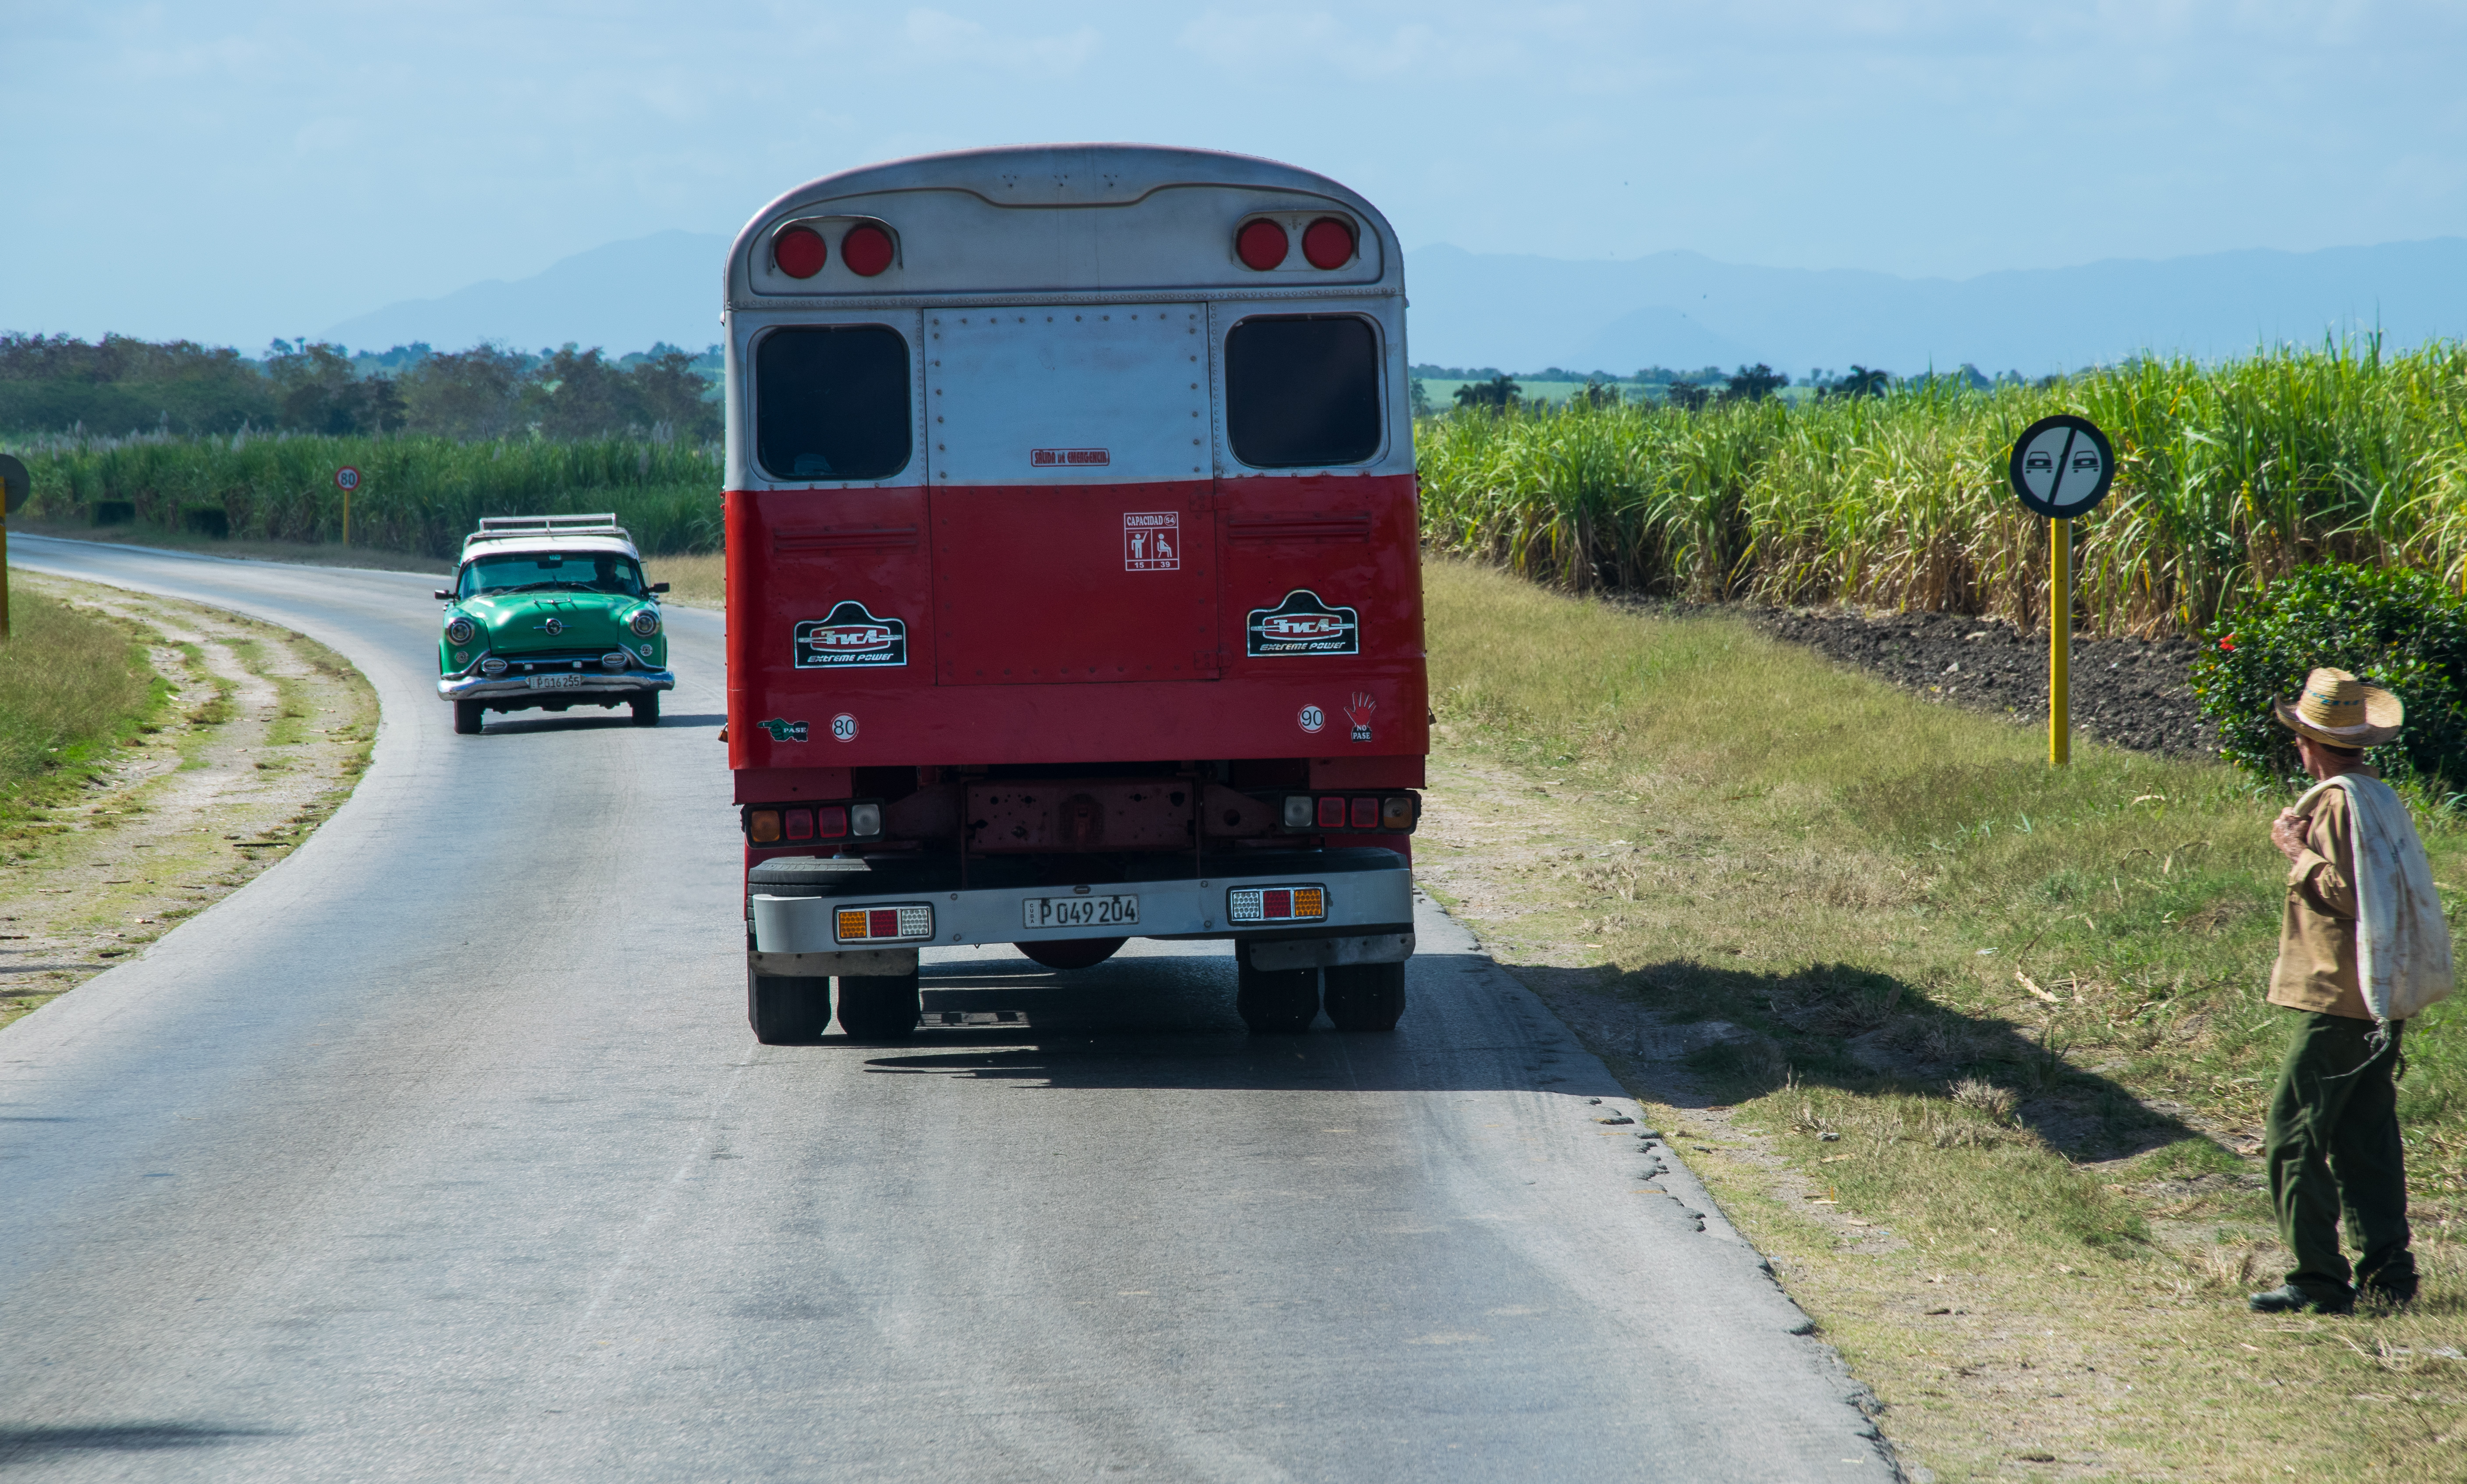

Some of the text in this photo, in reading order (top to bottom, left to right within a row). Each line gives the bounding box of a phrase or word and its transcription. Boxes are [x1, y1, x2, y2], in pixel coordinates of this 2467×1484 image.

[1035, 451, 1056, 464] SALIDA
[1067, 451, 1107, 464] EMERGENCIA
[341, 473, 355, 485] 80
[1127, 516, 1163, 526] CAPACIDAD
[1301, 710, 1324, 726] 90
[833, 719, 855, 736] 80
